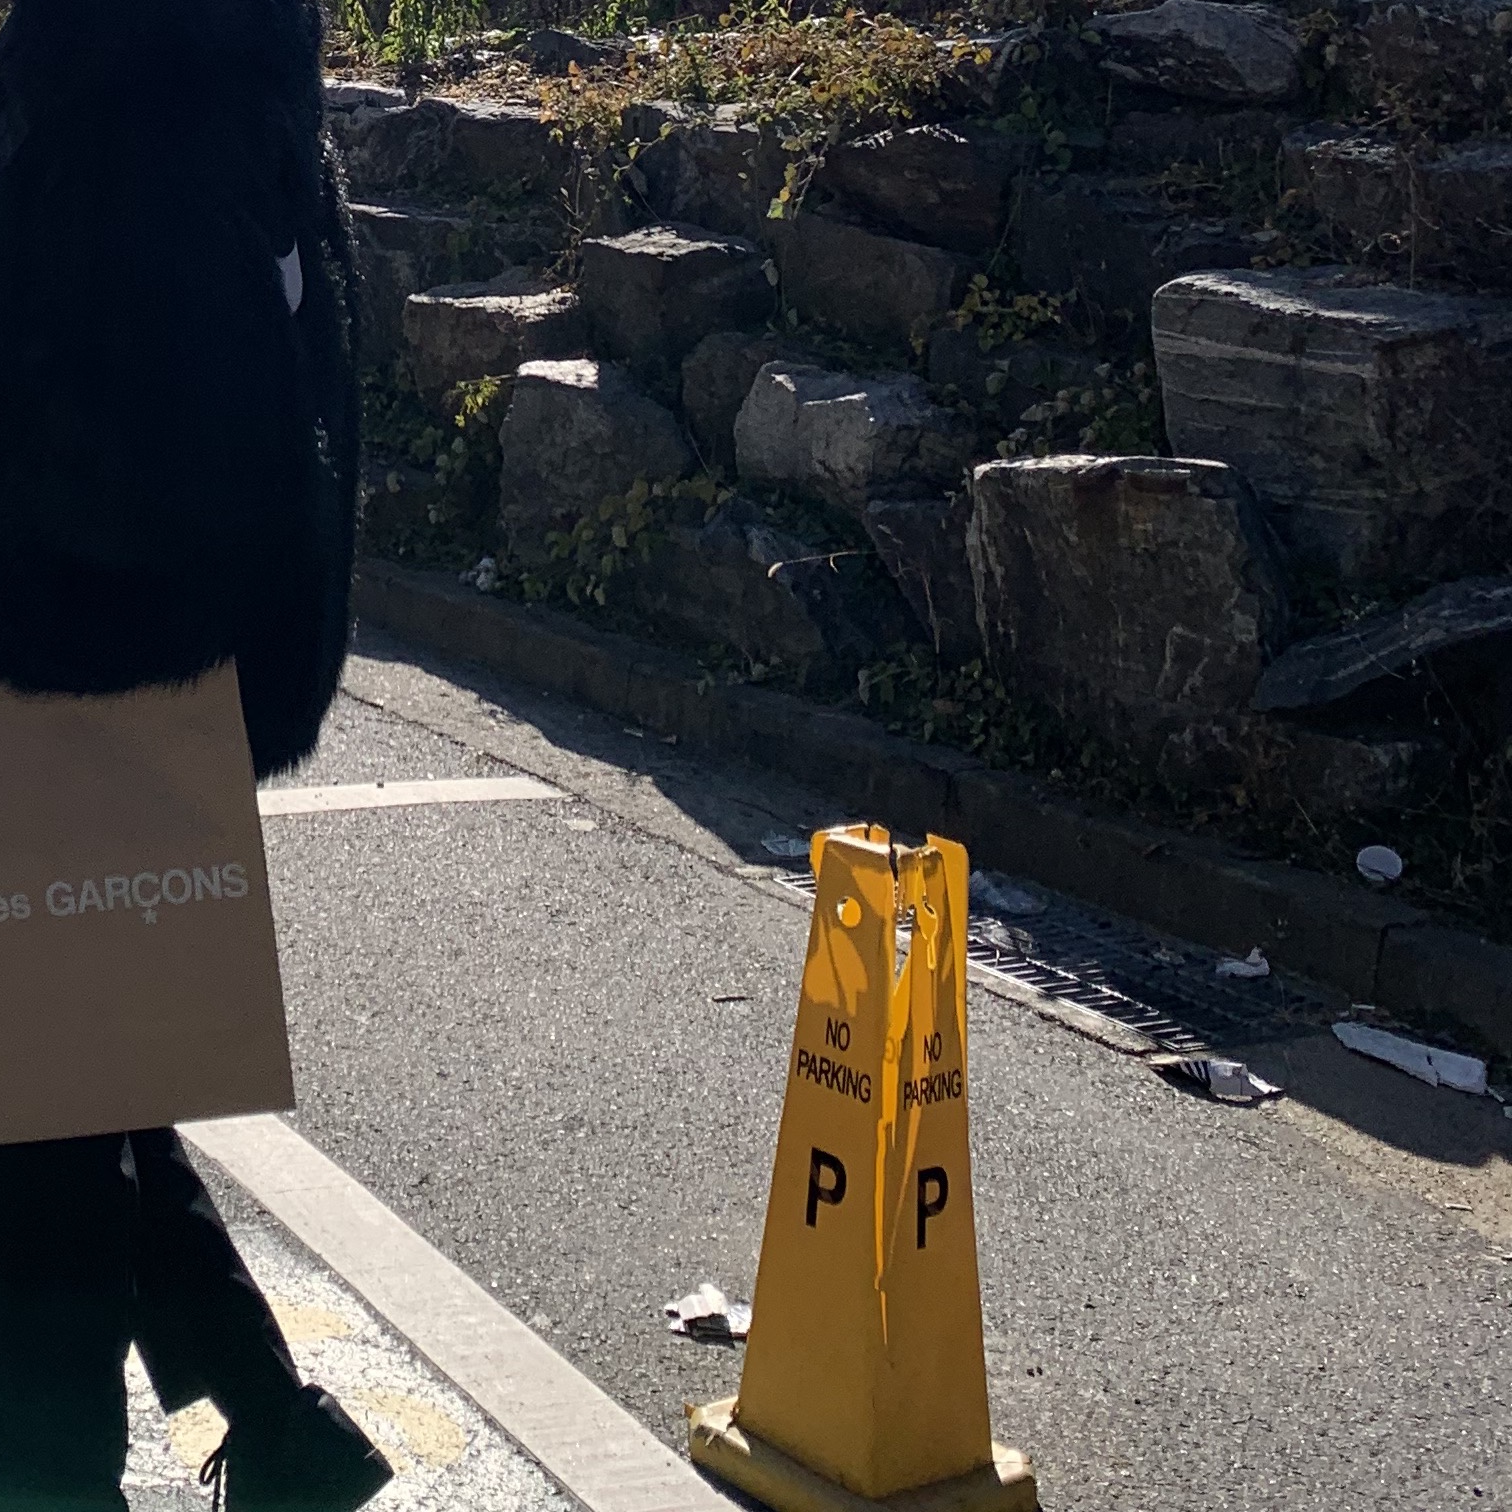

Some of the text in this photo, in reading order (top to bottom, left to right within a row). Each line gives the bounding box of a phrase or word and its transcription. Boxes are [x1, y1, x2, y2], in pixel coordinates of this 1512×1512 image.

[45, 863, 250, 926] GARÇONS
[825, 1016, 851, 1051] NO
[922, 1031, 943, 1064] NO
[796, 1047, 871, 1103] PARKING
[902, 1070, 963, 1110] PARKING
[805, 1147, 847, 1228] P
[916, 1166, 949, 1250] P
